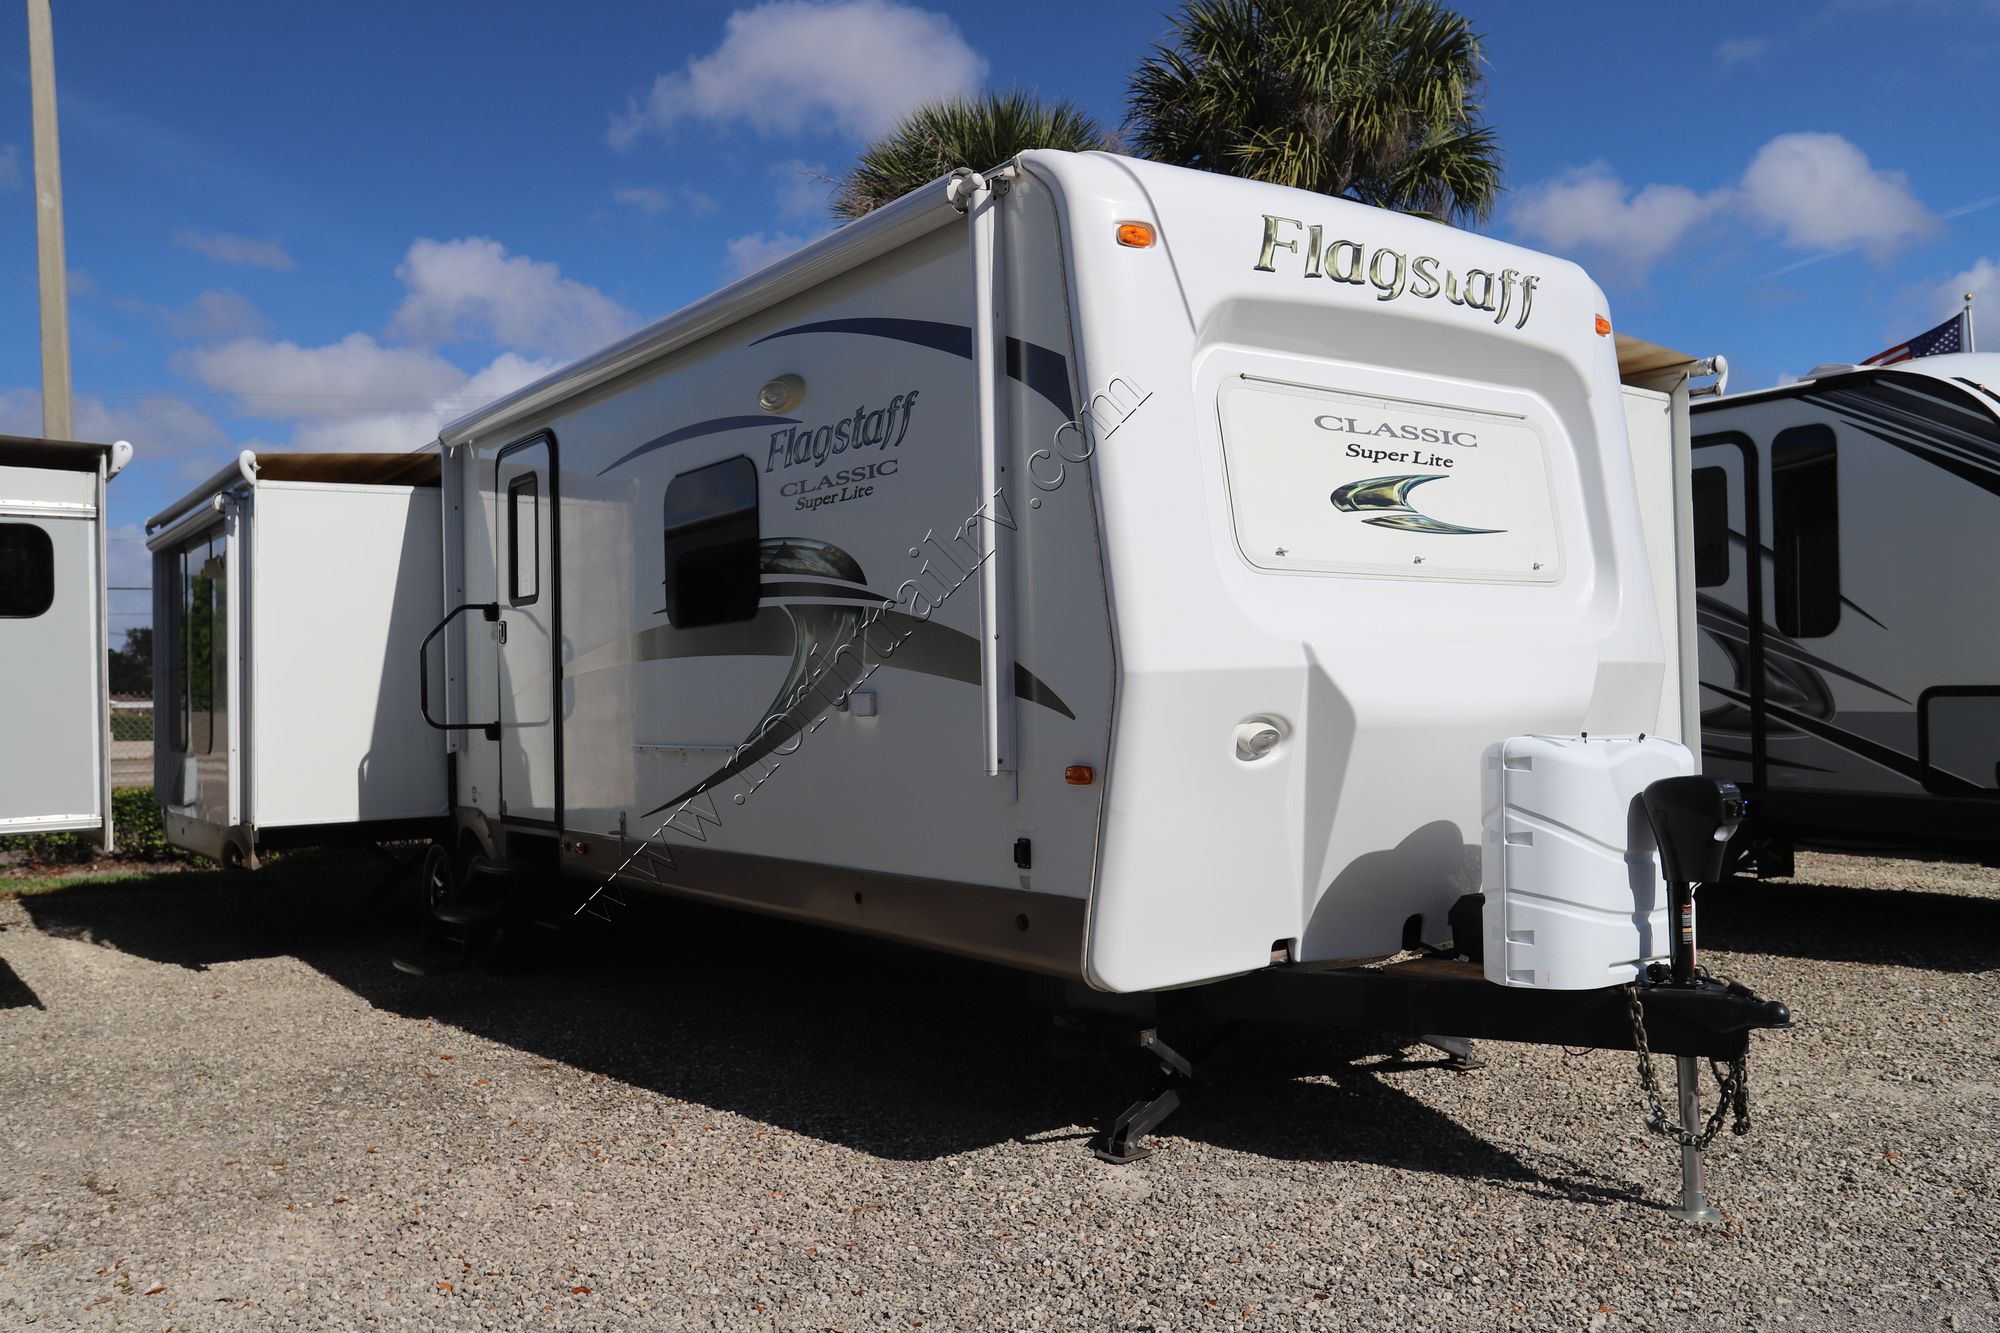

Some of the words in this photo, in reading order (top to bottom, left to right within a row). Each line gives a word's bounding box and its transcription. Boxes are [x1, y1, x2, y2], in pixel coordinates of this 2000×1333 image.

[1253, 213, 1540, 330] Flagstaff
[765, 390, 919, 473] Flagstaff
[1314, 414, 1478, 448] CLASSIC
[1345, 443, 1409, 464] Super
[1411, 450, 1454, 468] Lite
[780, 459, 898, 497] CLASSIC
[795, 493, 838, 511] Super
[839, 485, 874, 502] Lite
